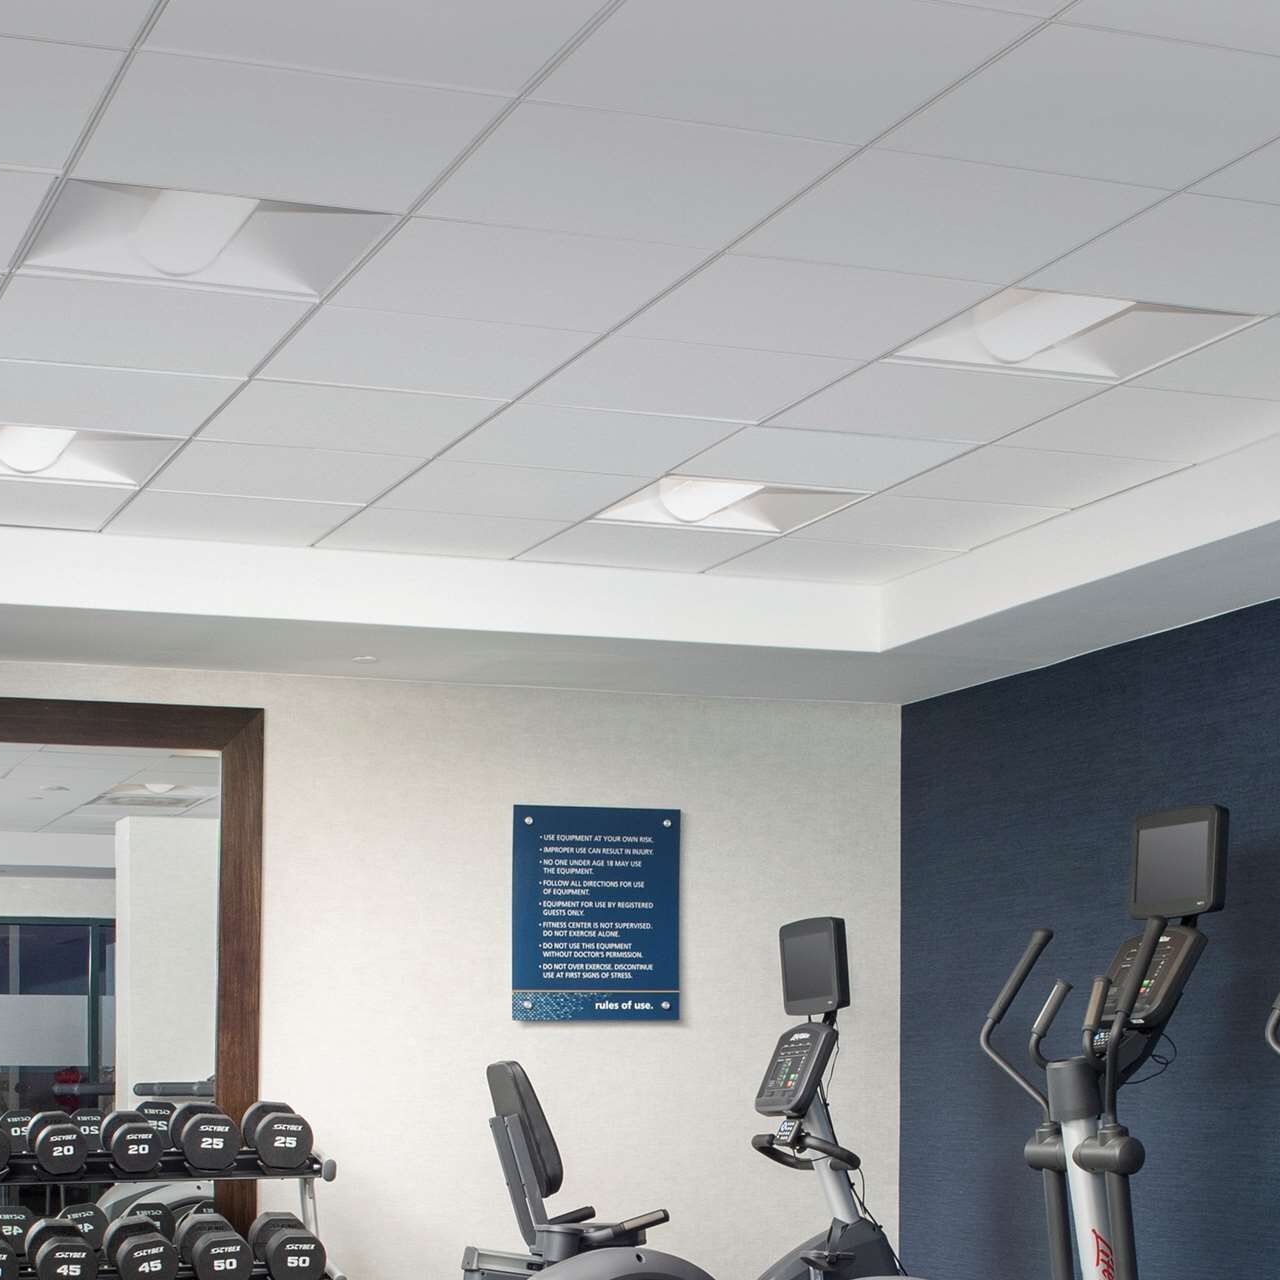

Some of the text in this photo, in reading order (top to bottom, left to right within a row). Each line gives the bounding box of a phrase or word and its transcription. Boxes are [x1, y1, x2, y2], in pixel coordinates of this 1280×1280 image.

[595, 1001, 619, 1009] rules
[621, 1001, 632, 1009] of
[201, 1138, 224, 1148] 25
[274, 1136, 296, 1147] 25
[53, 1146, 73, 1156] 20
[128, 1145, 148, 1154] 20
[144, 1246, 164, 1254] CYBEX
[220, 1246, 241, 1254] CYBEX
[139, 1260, 161, 1272] 45
[214, 1259, 237, 1270] 50
[288, 1257, 309, 1266] 50
[57, 1265, 80, 1275] 45
